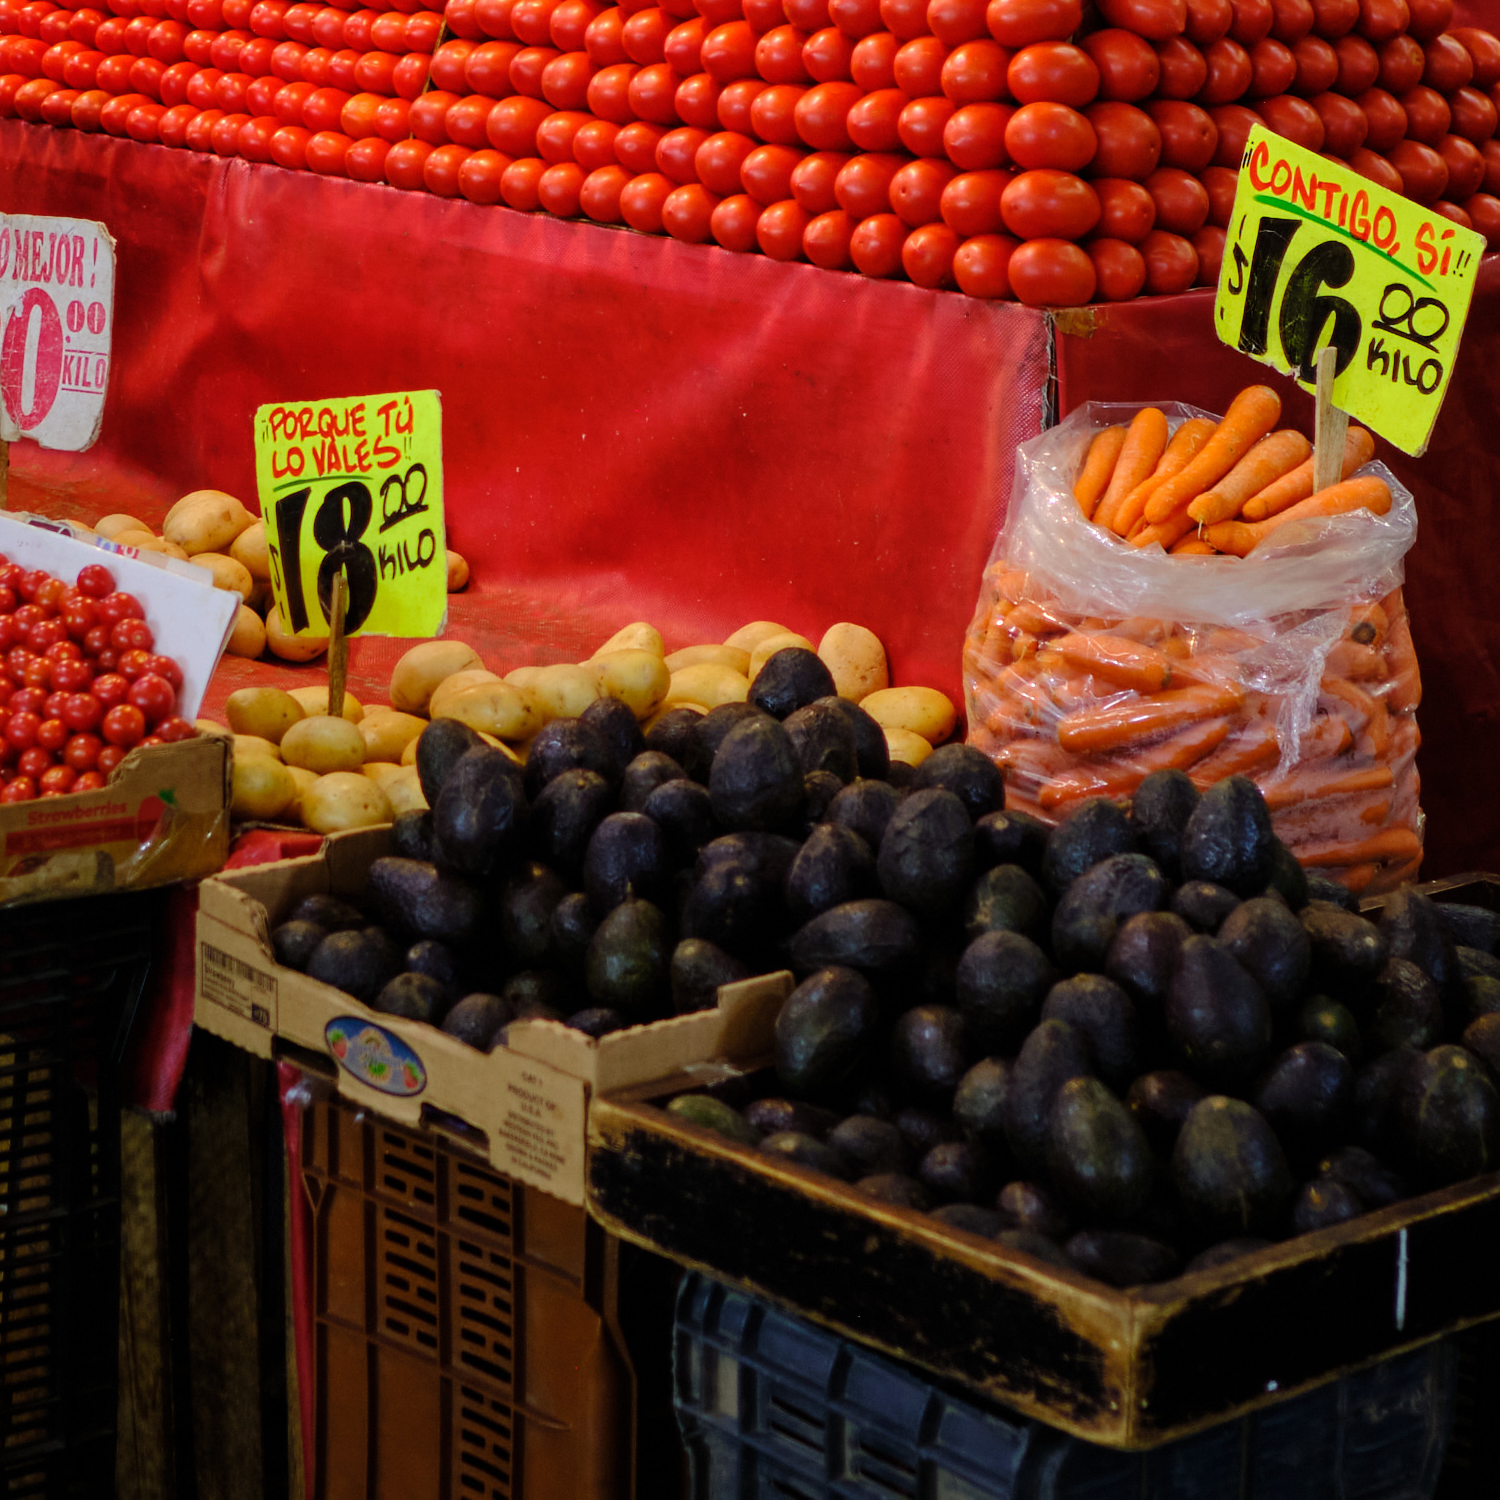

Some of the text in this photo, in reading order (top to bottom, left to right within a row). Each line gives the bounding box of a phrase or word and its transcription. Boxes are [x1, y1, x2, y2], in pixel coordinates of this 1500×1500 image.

[61, 351, 107, 391] KILO
[1366, 337, 1445, 396] KILO
[377, 395, 414, 438] TÚ
[271, 445, 306, 479] LO
[378, 527, 437, 582] KILO
[26, 800, 128, 826] Strawberries
